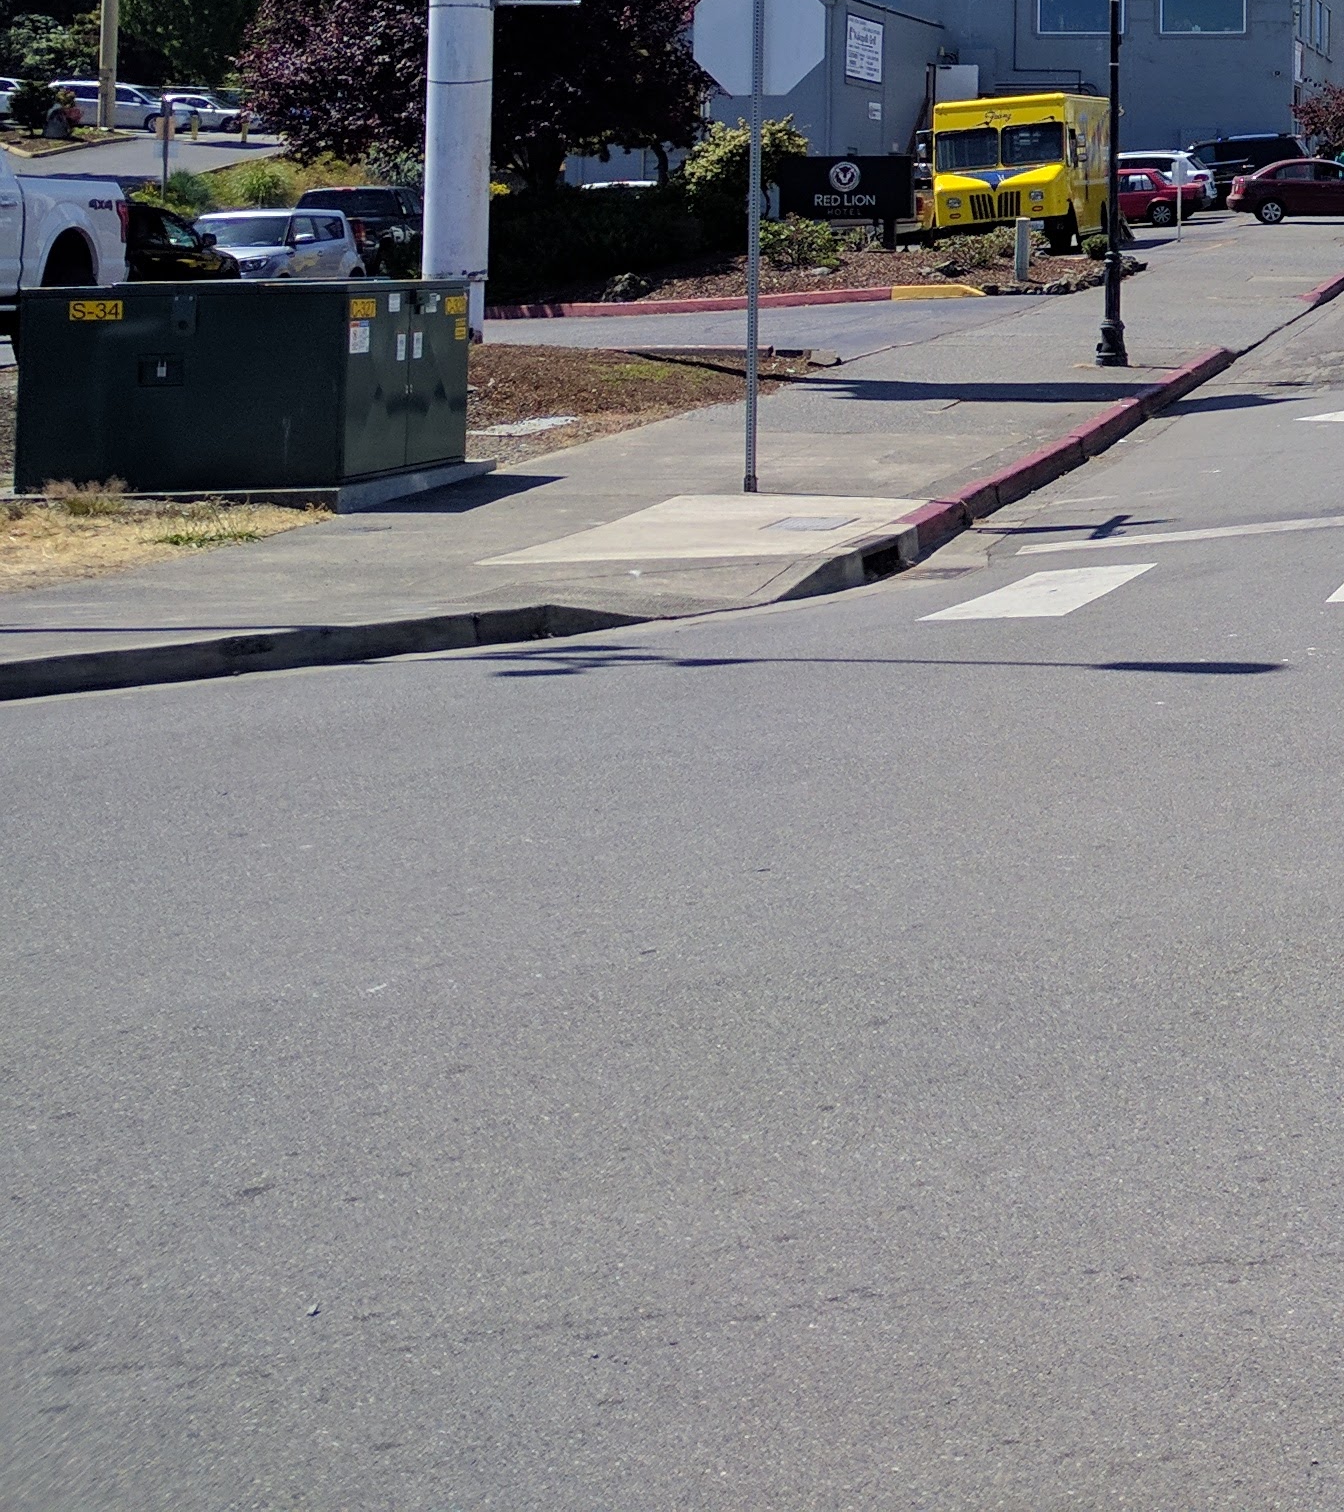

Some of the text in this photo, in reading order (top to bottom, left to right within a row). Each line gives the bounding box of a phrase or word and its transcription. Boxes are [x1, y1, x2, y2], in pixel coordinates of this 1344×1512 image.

[814, 194, 876, 206] RED LION
[71, 302, 120, 320] S-34
